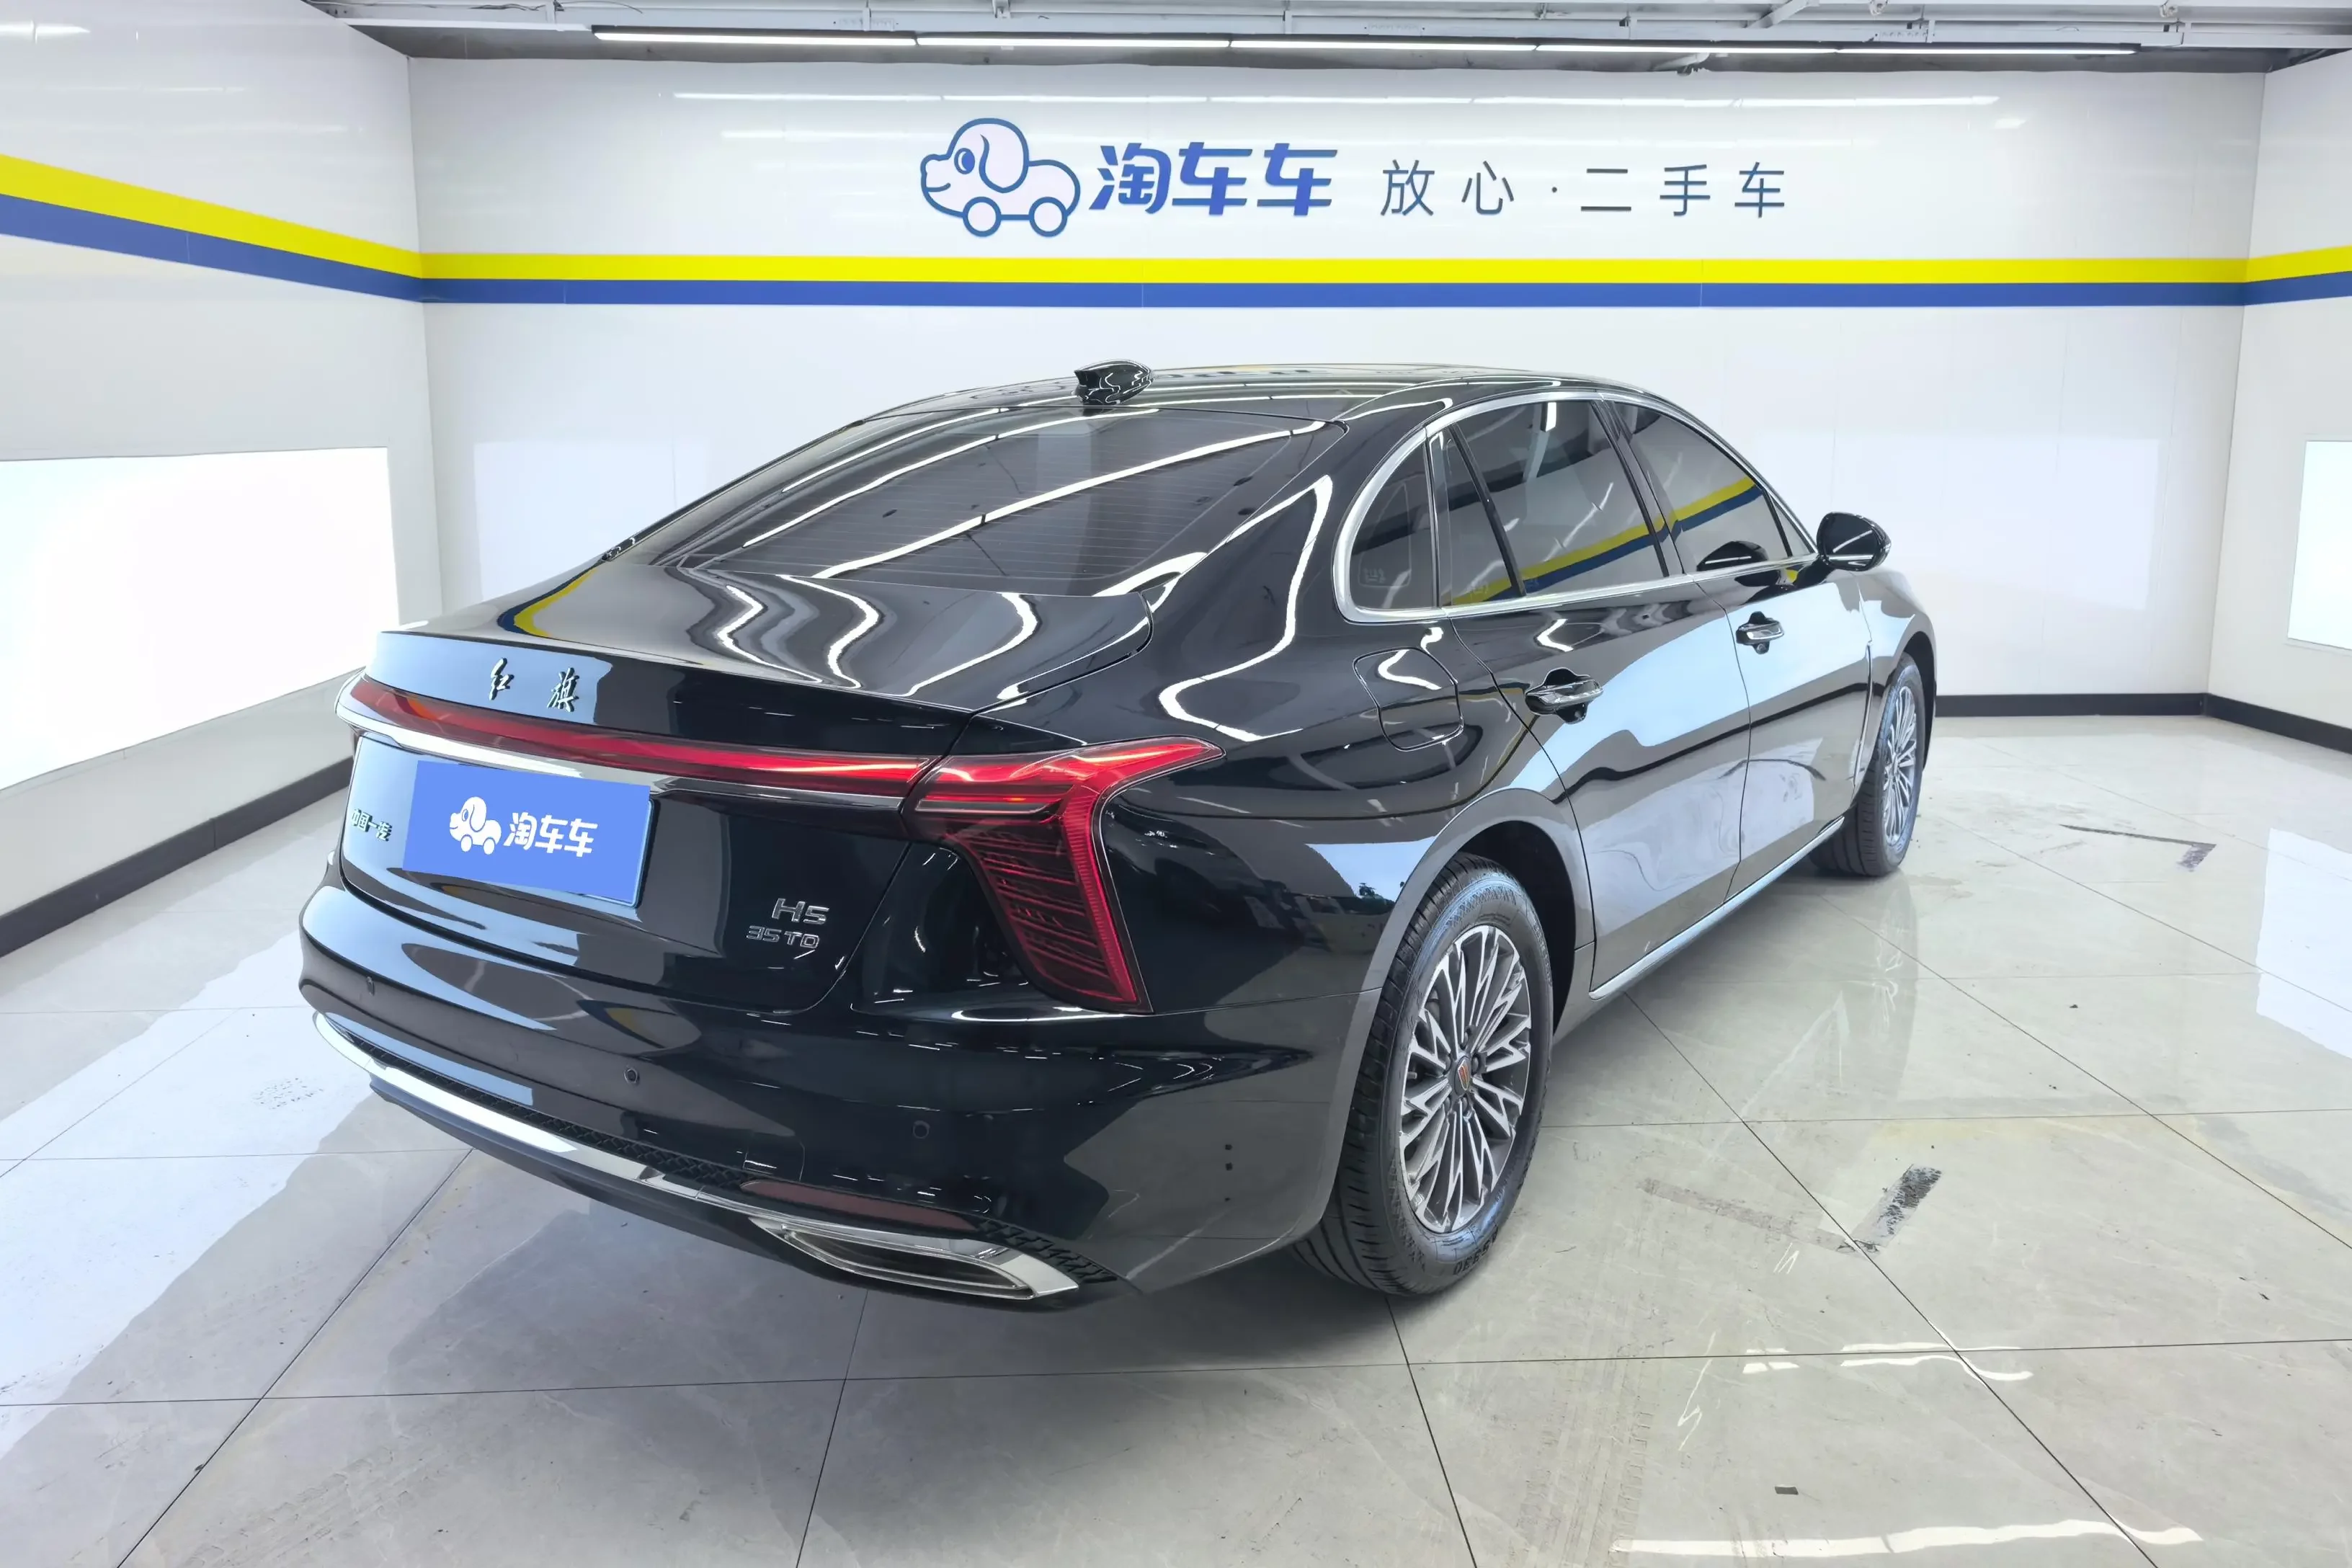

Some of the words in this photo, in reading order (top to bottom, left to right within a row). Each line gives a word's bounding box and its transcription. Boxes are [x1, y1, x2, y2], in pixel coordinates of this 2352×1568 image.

[1089, 142, 1338, 216] 淘车车
[489, 657, 579, 712] 红旗
[352, 808, 392, 842] 中国一汽
